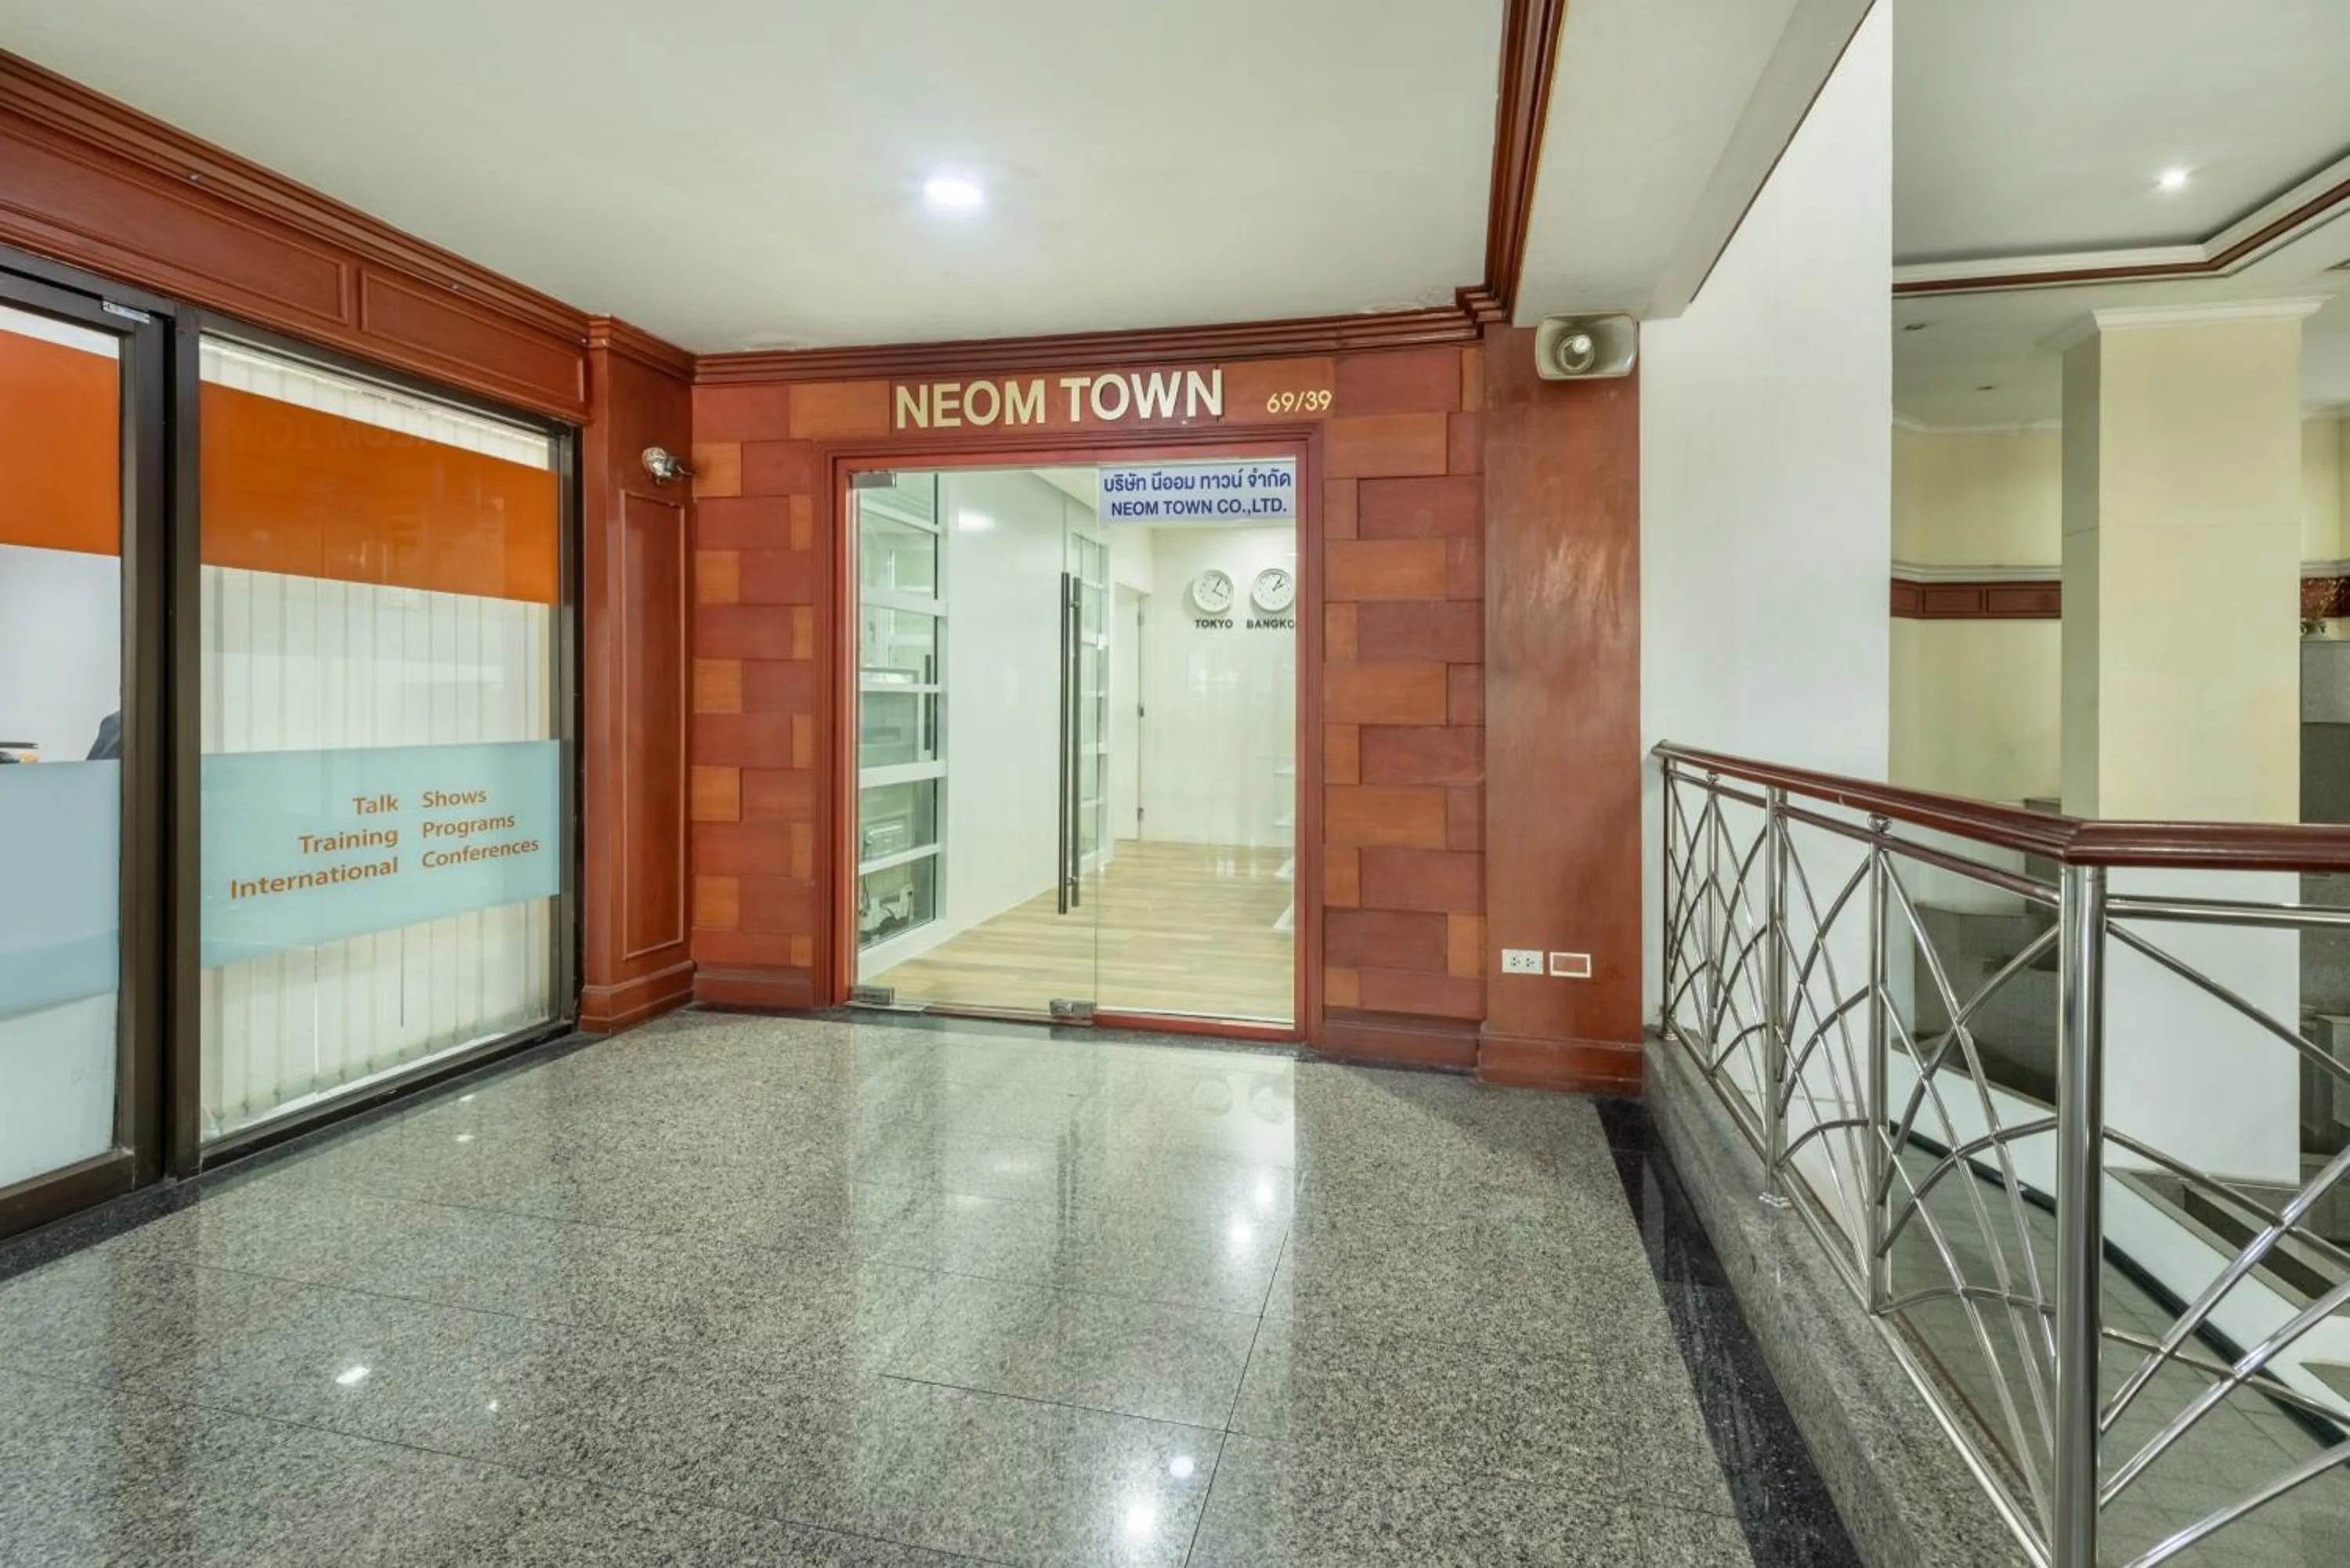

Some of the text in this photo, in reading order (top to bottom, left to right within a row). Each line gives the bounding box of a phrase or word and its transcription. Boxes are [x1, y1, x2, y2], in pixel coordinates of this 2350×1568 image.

[895, 369, 1223, 429] NEOM TOWN
[1266, 390, 1332, 414] 69/39
[1104, 468, 1292, 493] บริษัท นีออม ทาวน์ จำกัด
[1111, 498, 1287, 516] NEOM TOWN CO.,LTD.
[1195, 620, 1234, 629] TOKYO
[352, 789, 486, 815] Talk Shows
[298, 813, 515, 854] Training Programs
[230, 837, 539, 900] International Conferences
